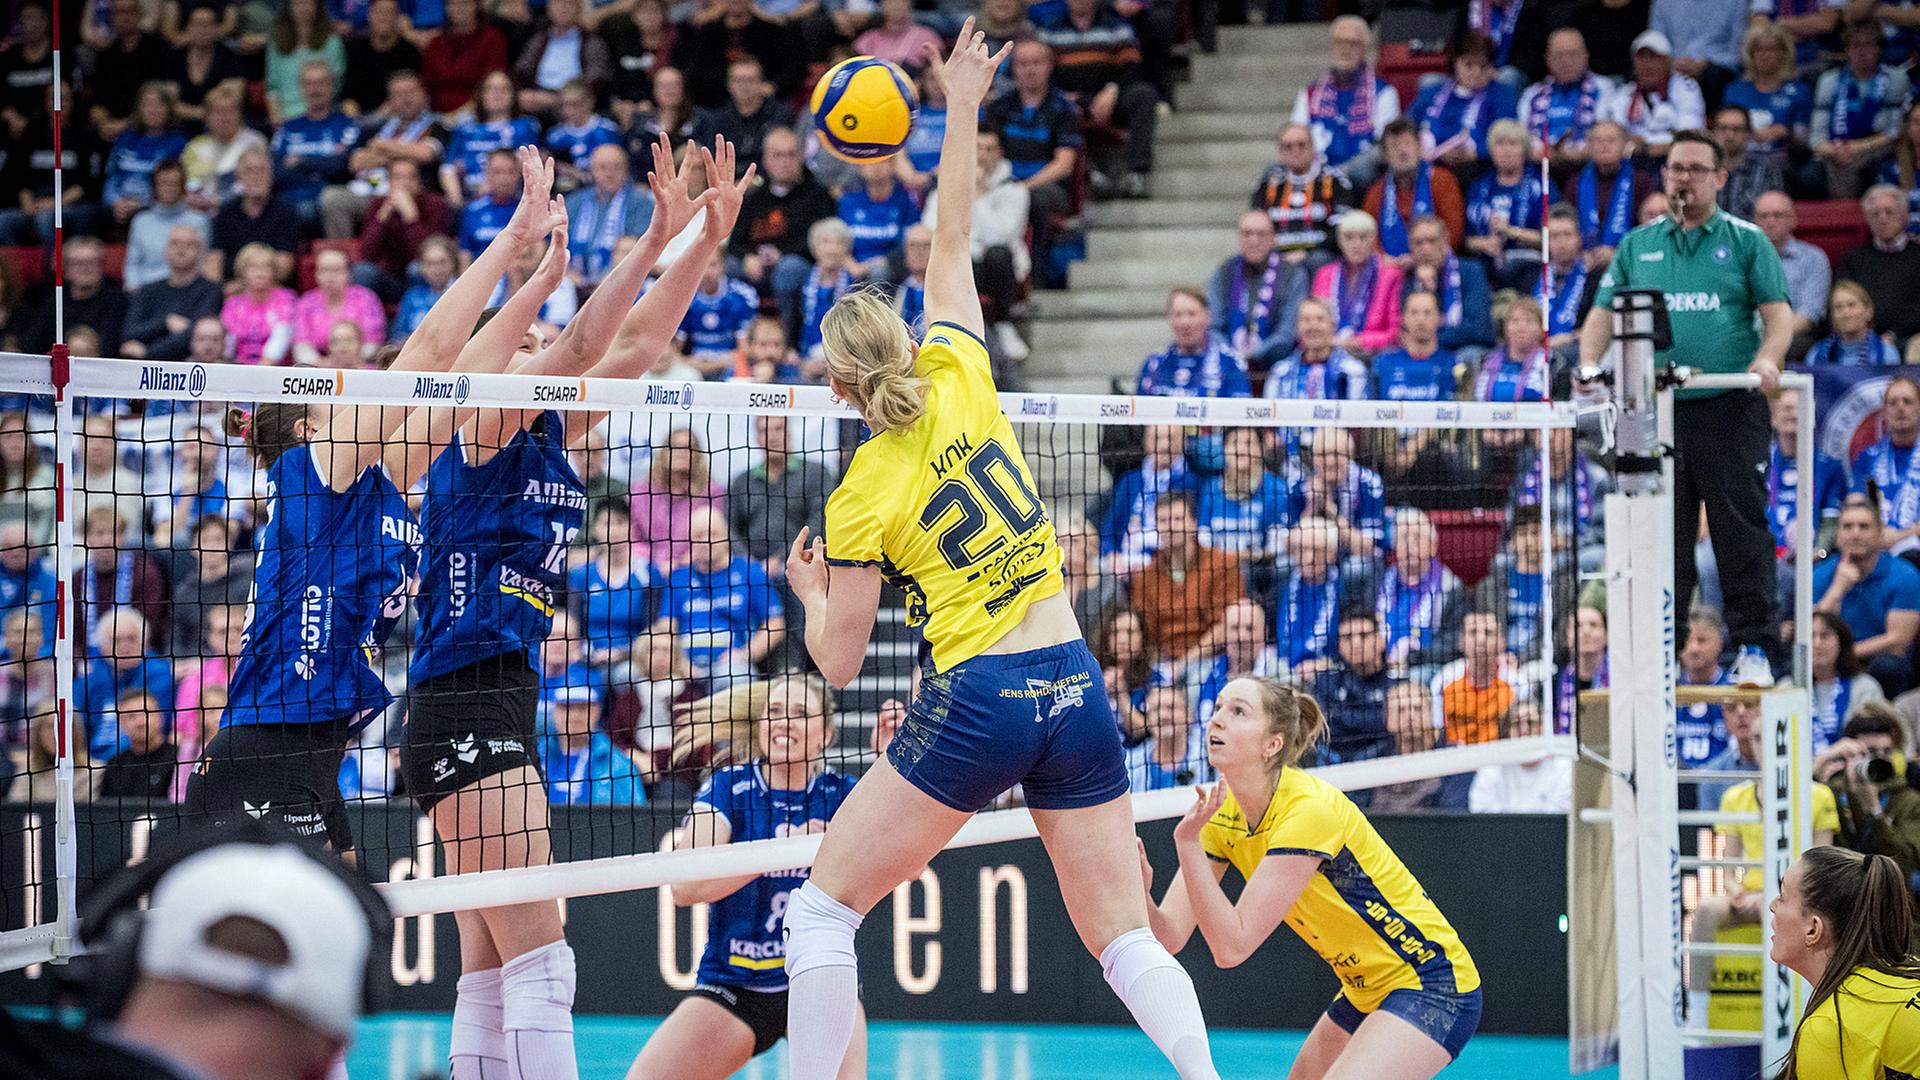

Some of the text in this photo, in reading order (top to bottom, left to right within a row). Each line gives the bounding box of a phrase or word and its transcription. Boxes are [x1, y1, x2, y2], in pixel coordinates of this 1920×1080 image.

[139, 367, 186, 391] Allianz
[281, 377, 334, 396] SCHARR
[412, 377, 453, 399] Allianz
[533, 384, 578, 402] SCHARR
[645, 384, 680, 406] Allianz
[748, 392, 787, 408] SCHARR
[1021, 398, 1047, 416] Allianz
[1100, 404, 1130, 417] SCHARR
[523, 478, 588, 511] Allian
[918, 438, 1042, 571] 20
[449, 552, 467, 618] LOTTO
[300, 584, 323, 653] LOTTO
[998, 688, 1024, 699] JENS
